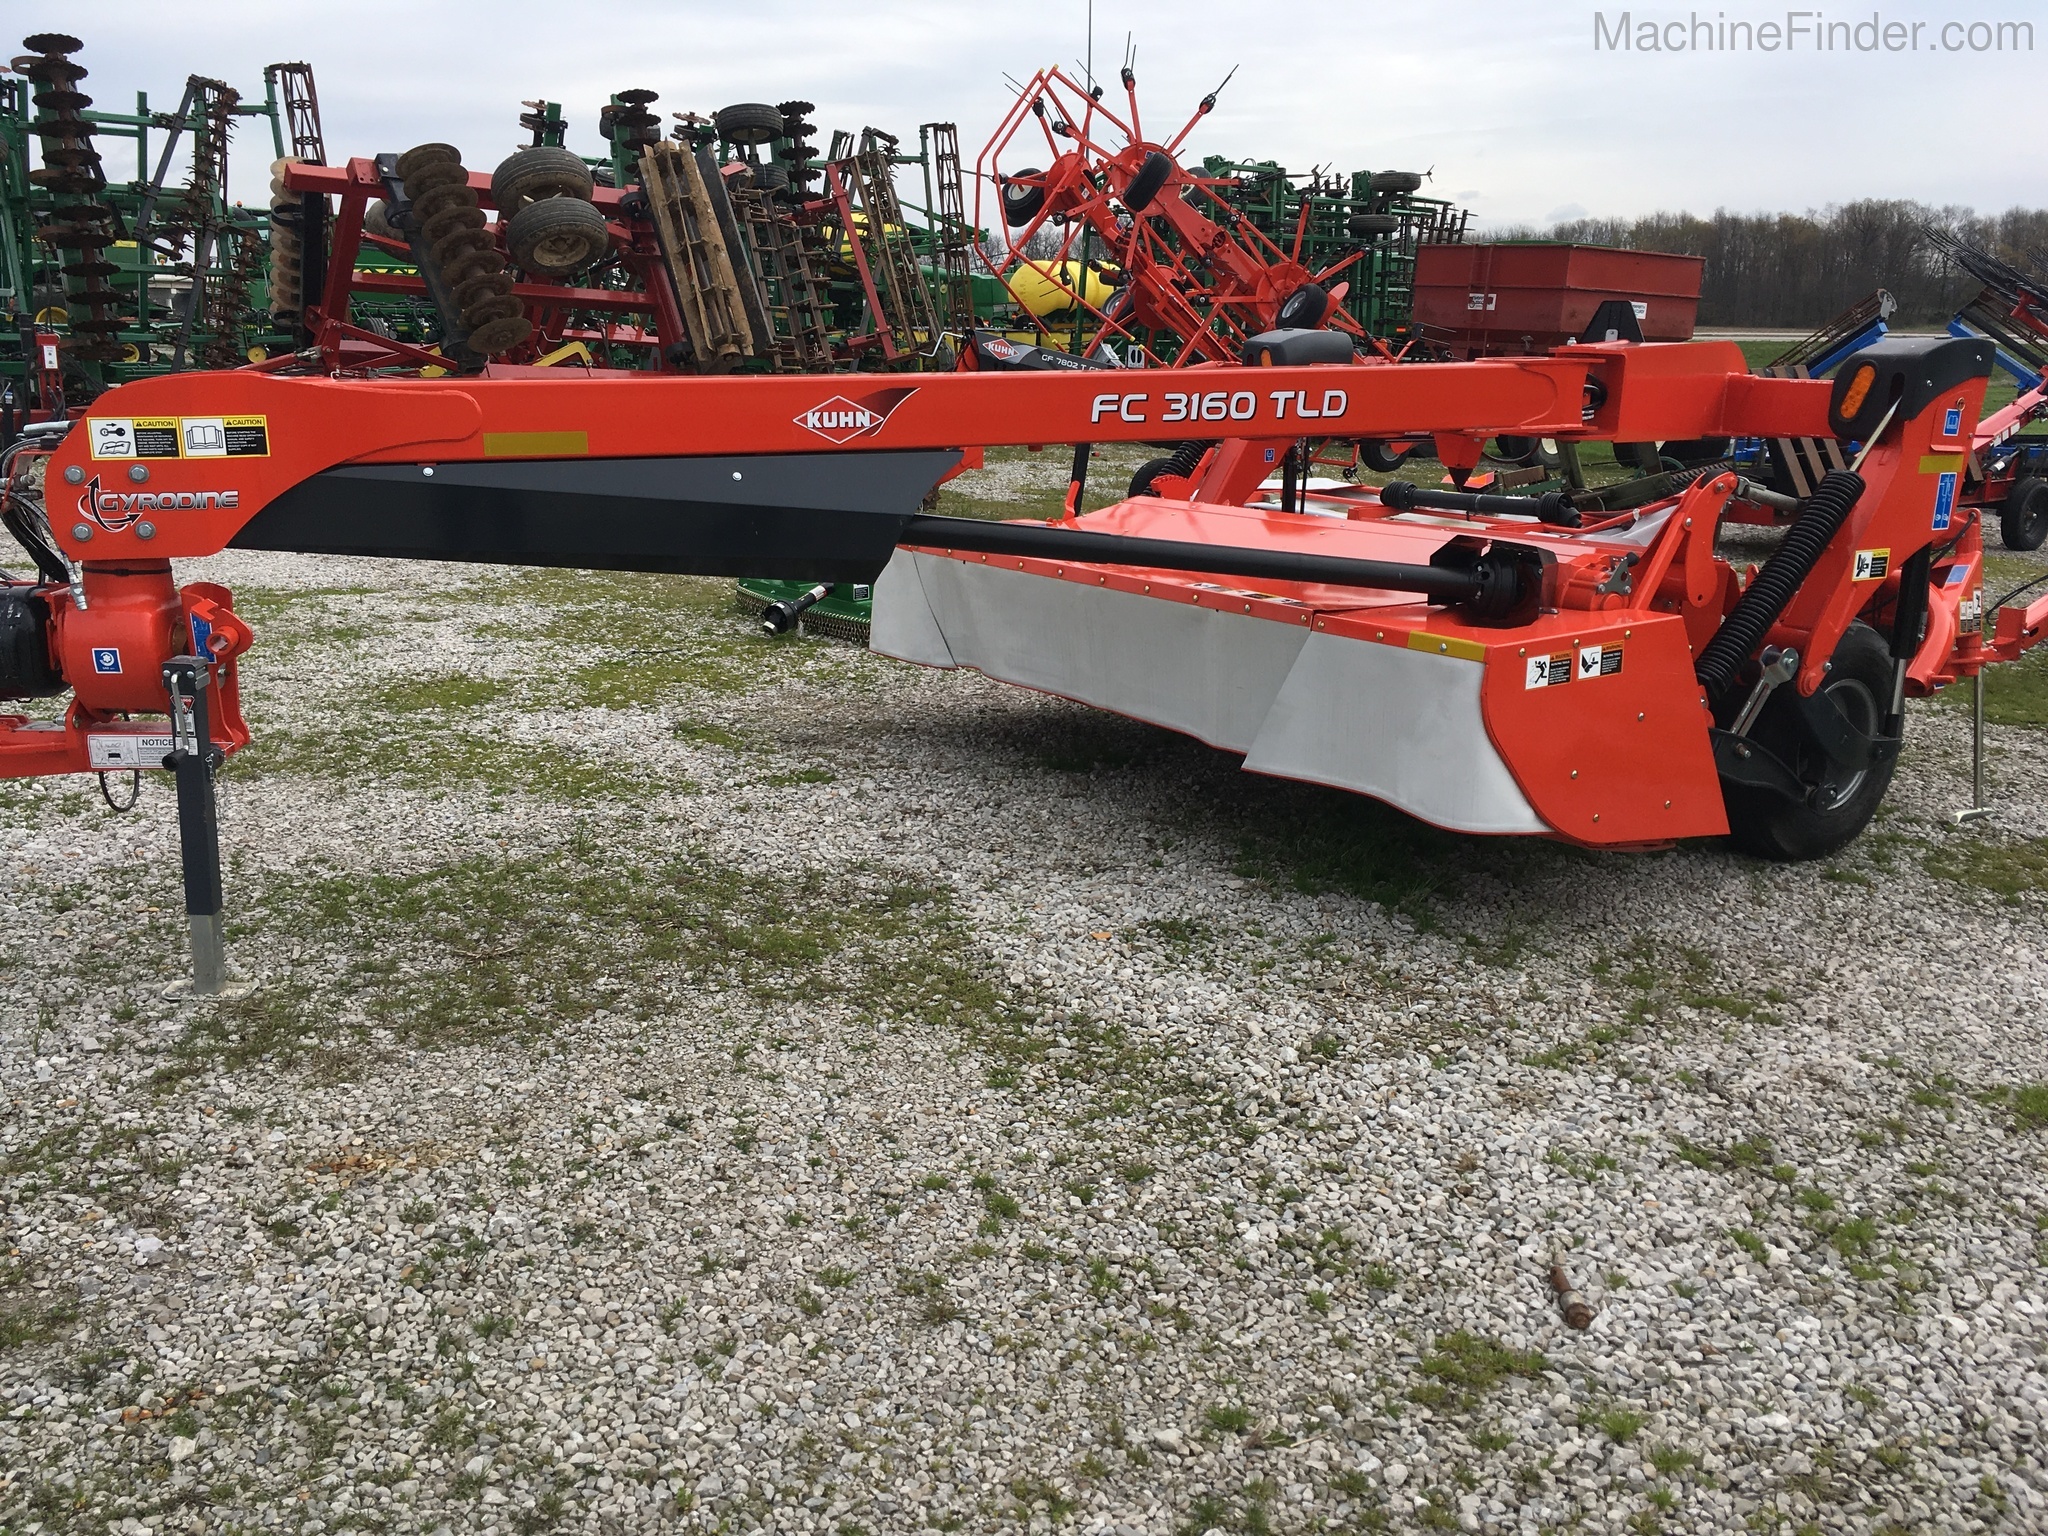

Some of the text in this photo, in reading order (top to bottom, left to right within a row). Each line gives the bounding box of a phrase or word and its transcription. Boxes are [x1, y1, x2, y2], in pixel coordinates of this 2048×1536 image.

[988, 342, 1016, 358] KUHN
[1041, 353, 1054, 363] GF
[1055, 357, 1079, 369] 7802
[1090, 389, 1349, 423] FC 3160 TLD
[806, 410, 873, 430] KUHN
[99, 490, 239, 512] GYRODINE
[141, 738, 174, 747] NOTICE
